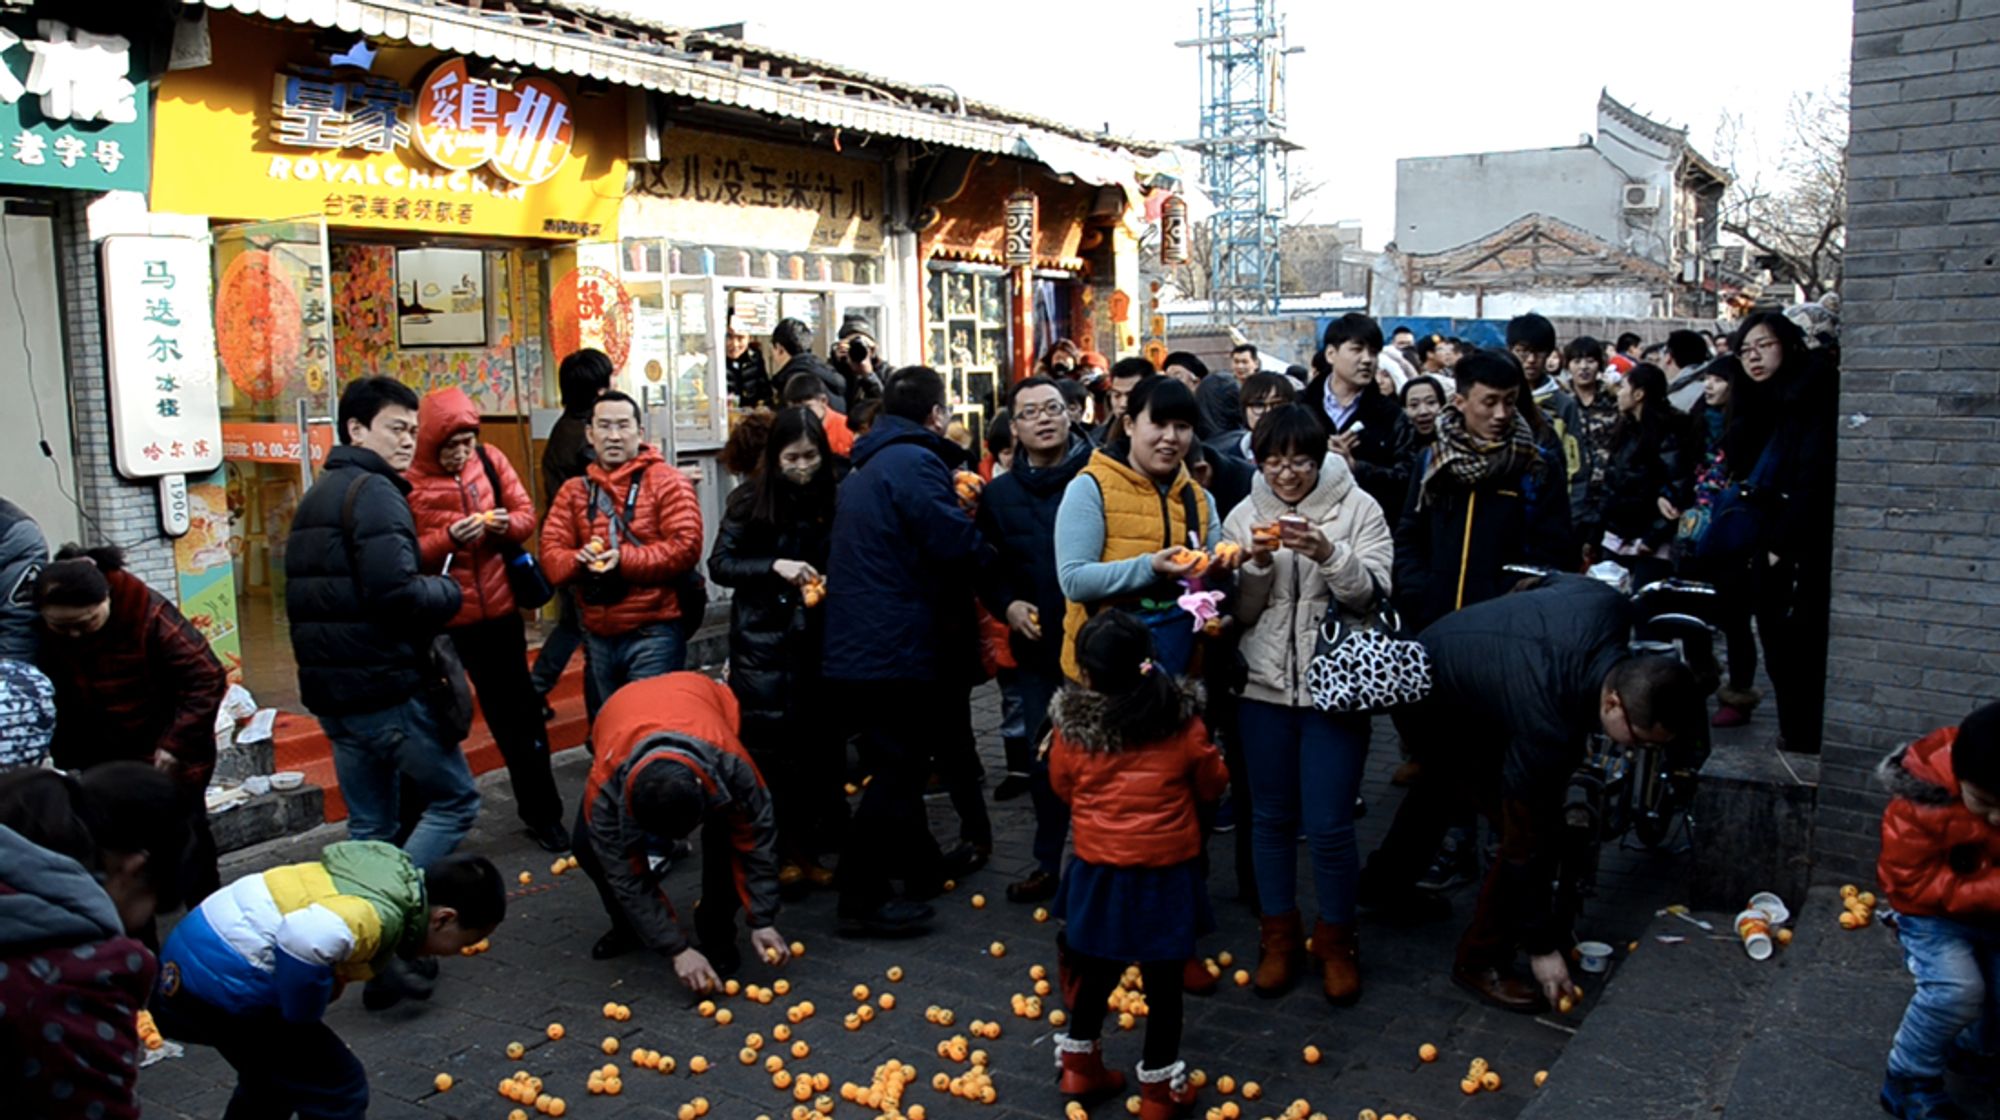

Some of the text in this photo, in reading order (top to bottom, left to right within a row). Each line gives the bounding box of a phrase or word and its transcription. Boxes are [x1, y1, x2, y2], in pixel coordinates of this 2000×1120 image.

[0, 130, 124, 173] 老字号
[634, 154, 874, 222] 这儿没玉米汁儿
[170, 481, 187, 522] 1906
